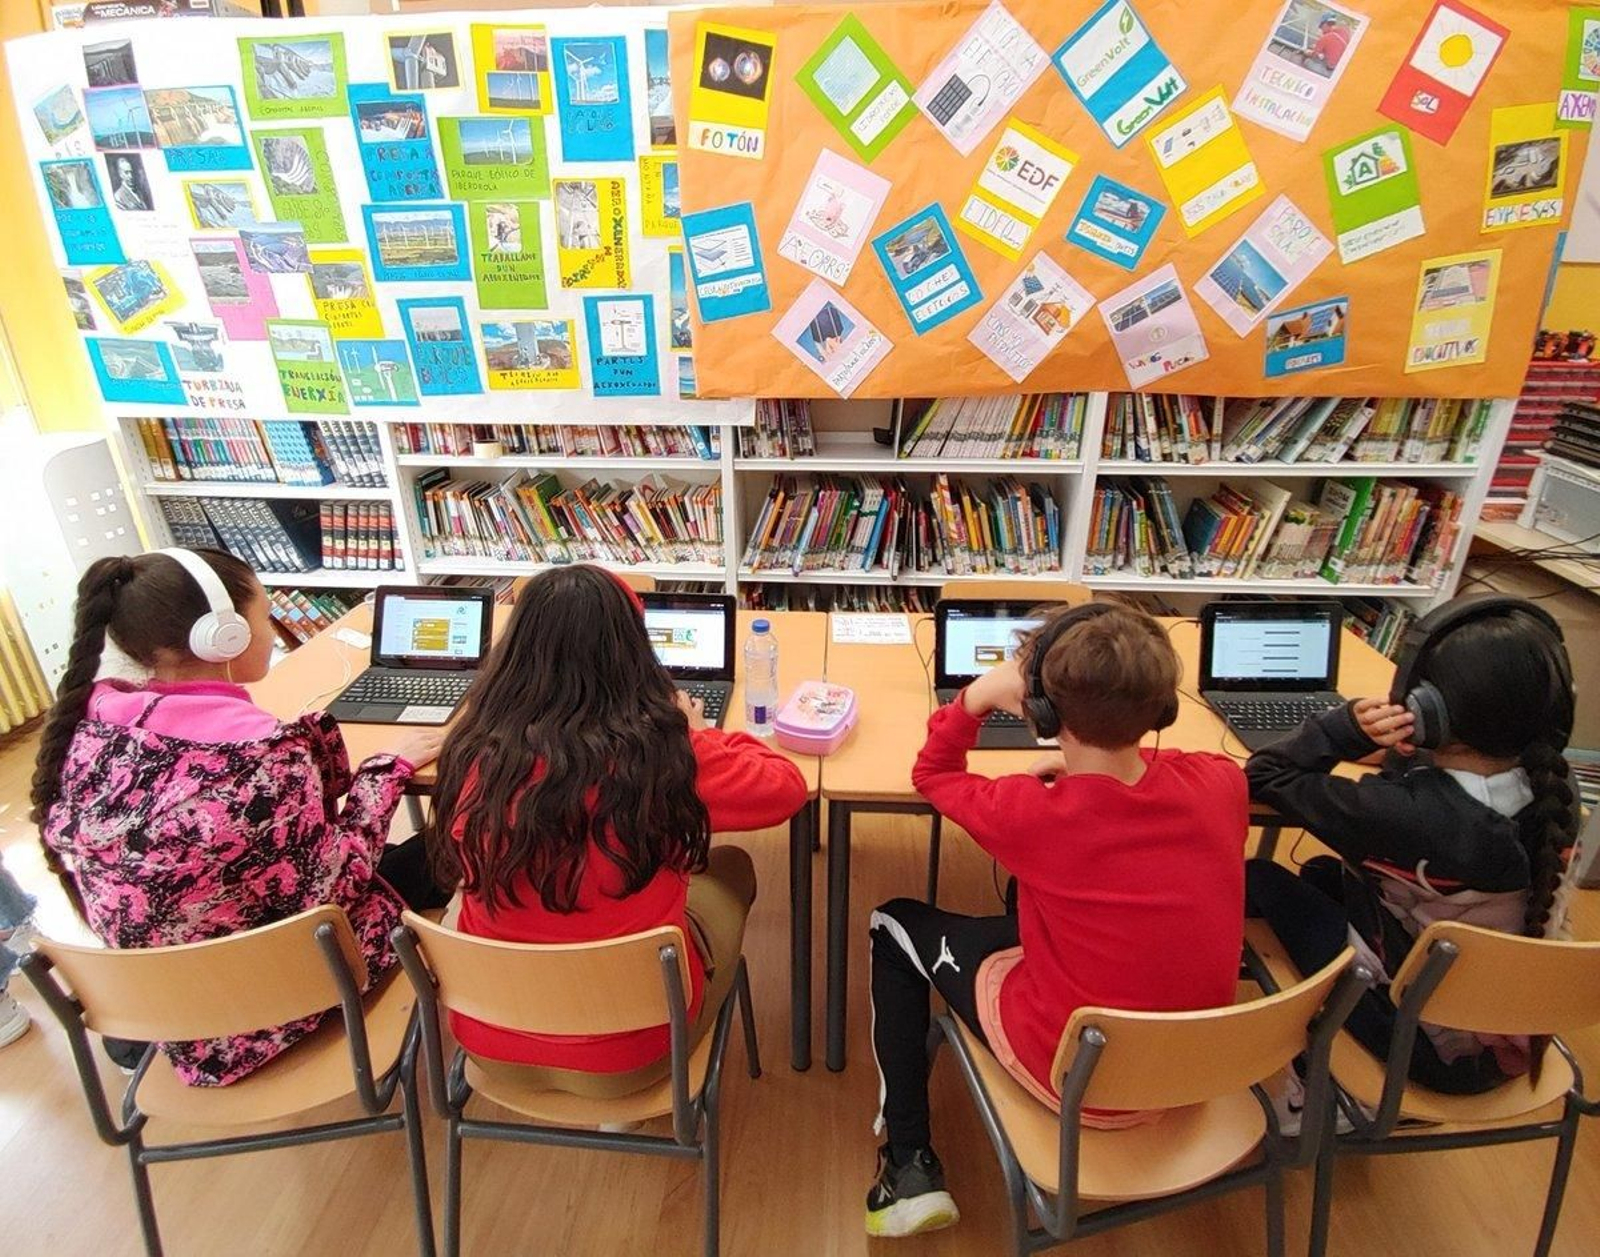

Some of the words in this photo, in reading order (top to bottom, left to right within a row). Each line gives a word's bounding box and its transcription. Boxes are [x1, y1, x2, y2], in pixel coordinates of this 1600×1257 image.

[1077, 37, 1131, 88] GreenVolt
[700, 128, 759, 153] FOTÓN
[451, 168, 485, 180] PARQUE
[524, 168, 535, 178] DE
[284, 383, 346, 403] ENERXÍA
[190, 396, 206, 408] DE
[208, 397, 246, 411] PRESA
